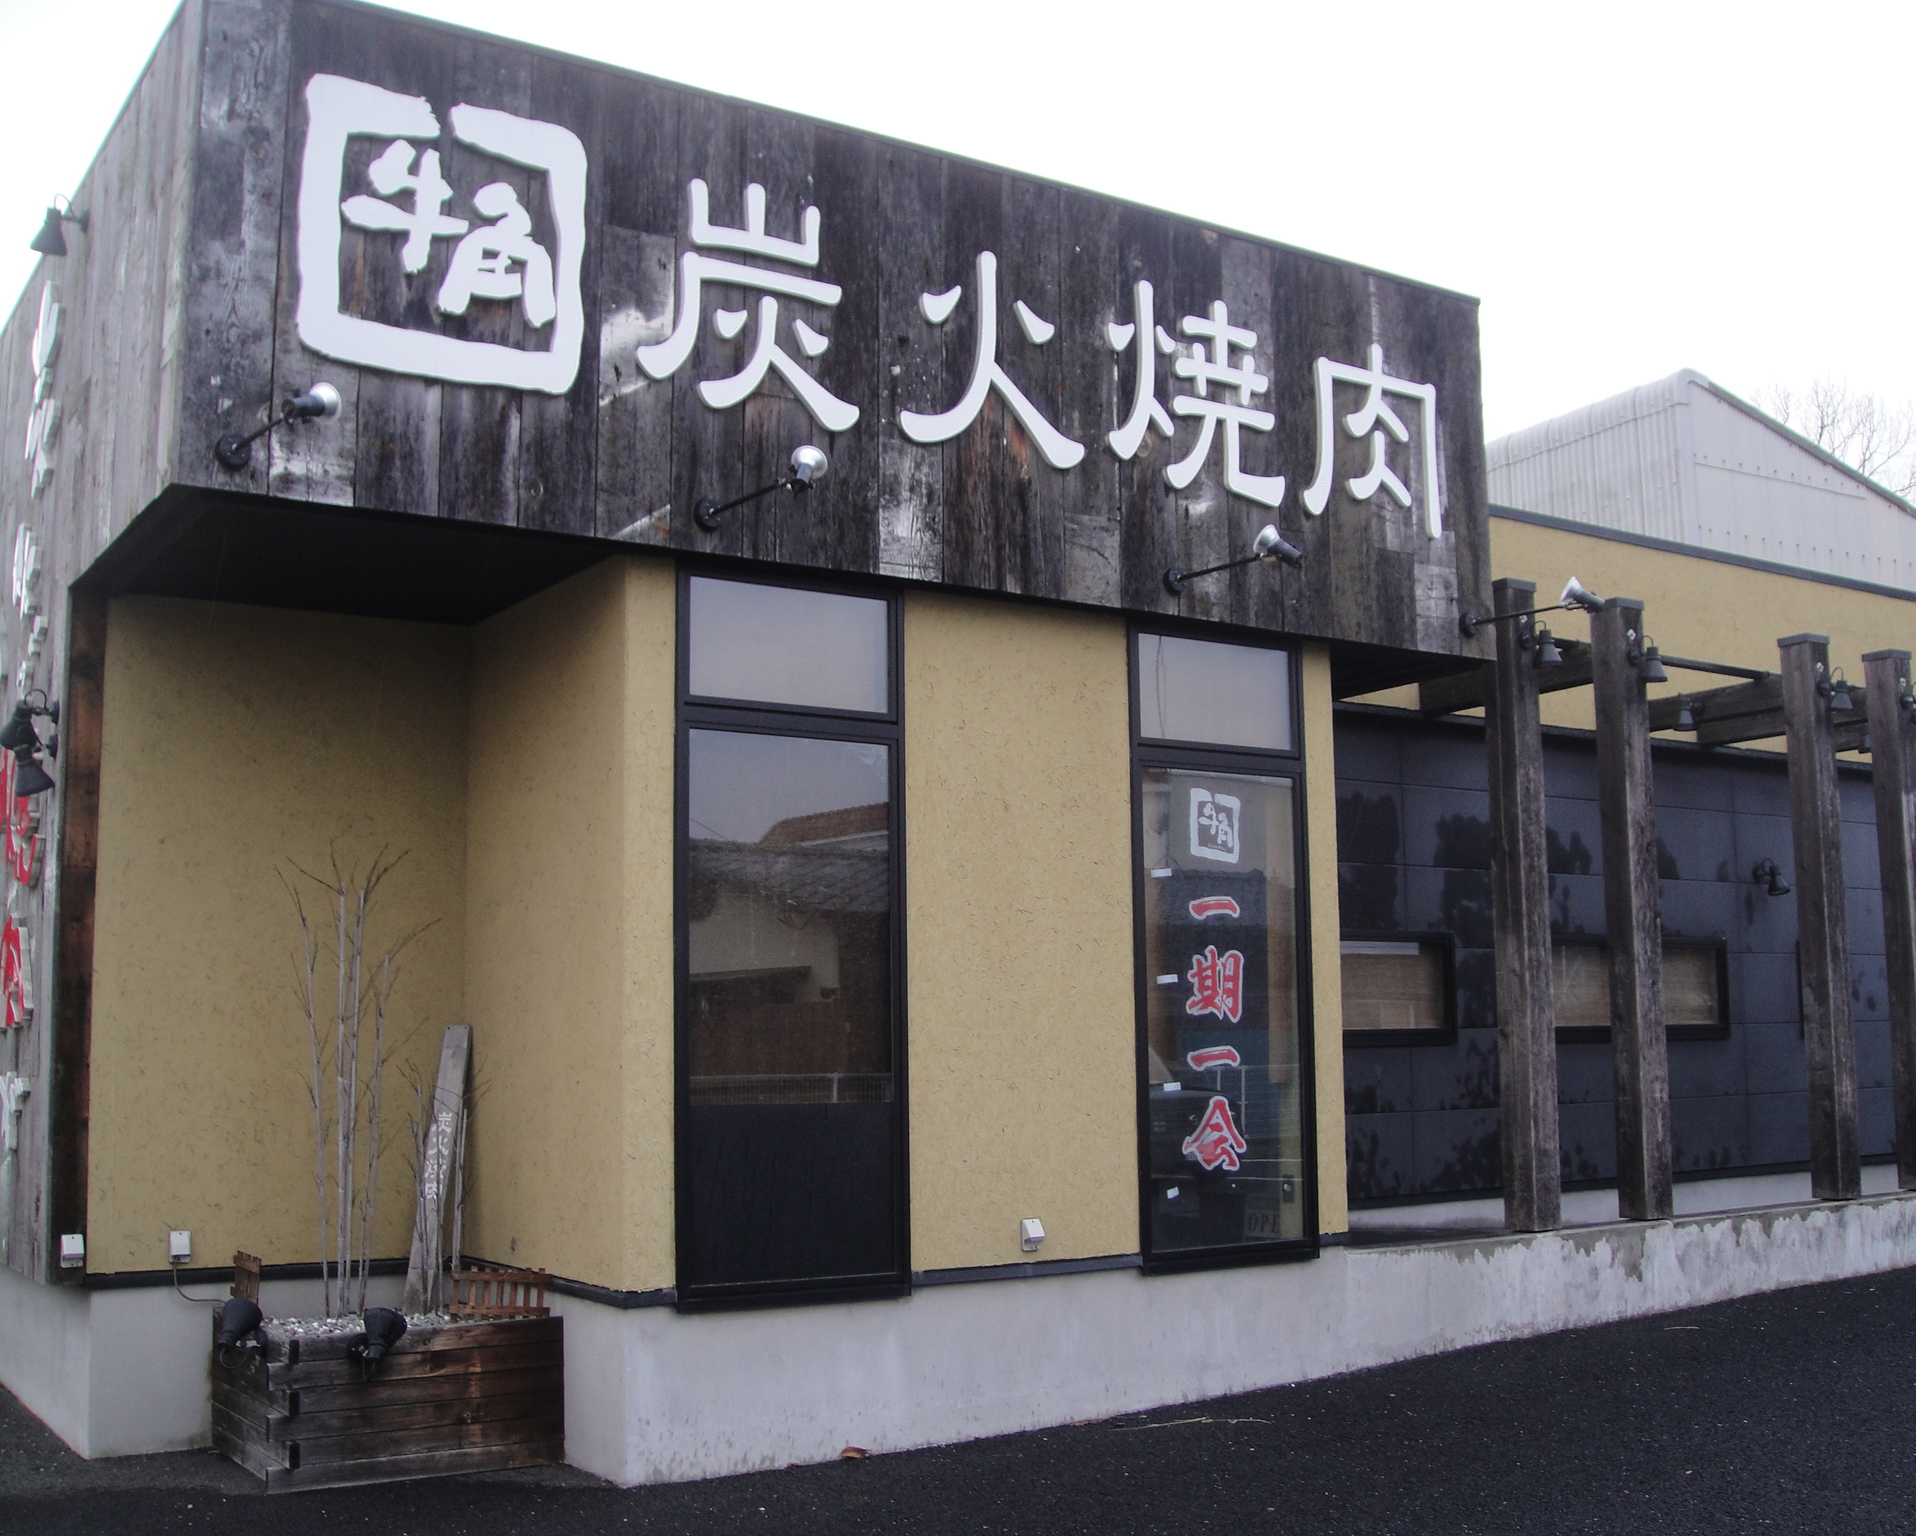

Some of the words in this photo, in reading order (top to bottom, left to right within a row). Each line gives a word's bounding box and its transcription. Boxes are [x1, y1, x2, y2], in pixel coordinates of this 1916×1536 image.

[637, 177, 1442, 540] 炭火焼肉
[1182, 895, 1247, 1171] 一期一会
